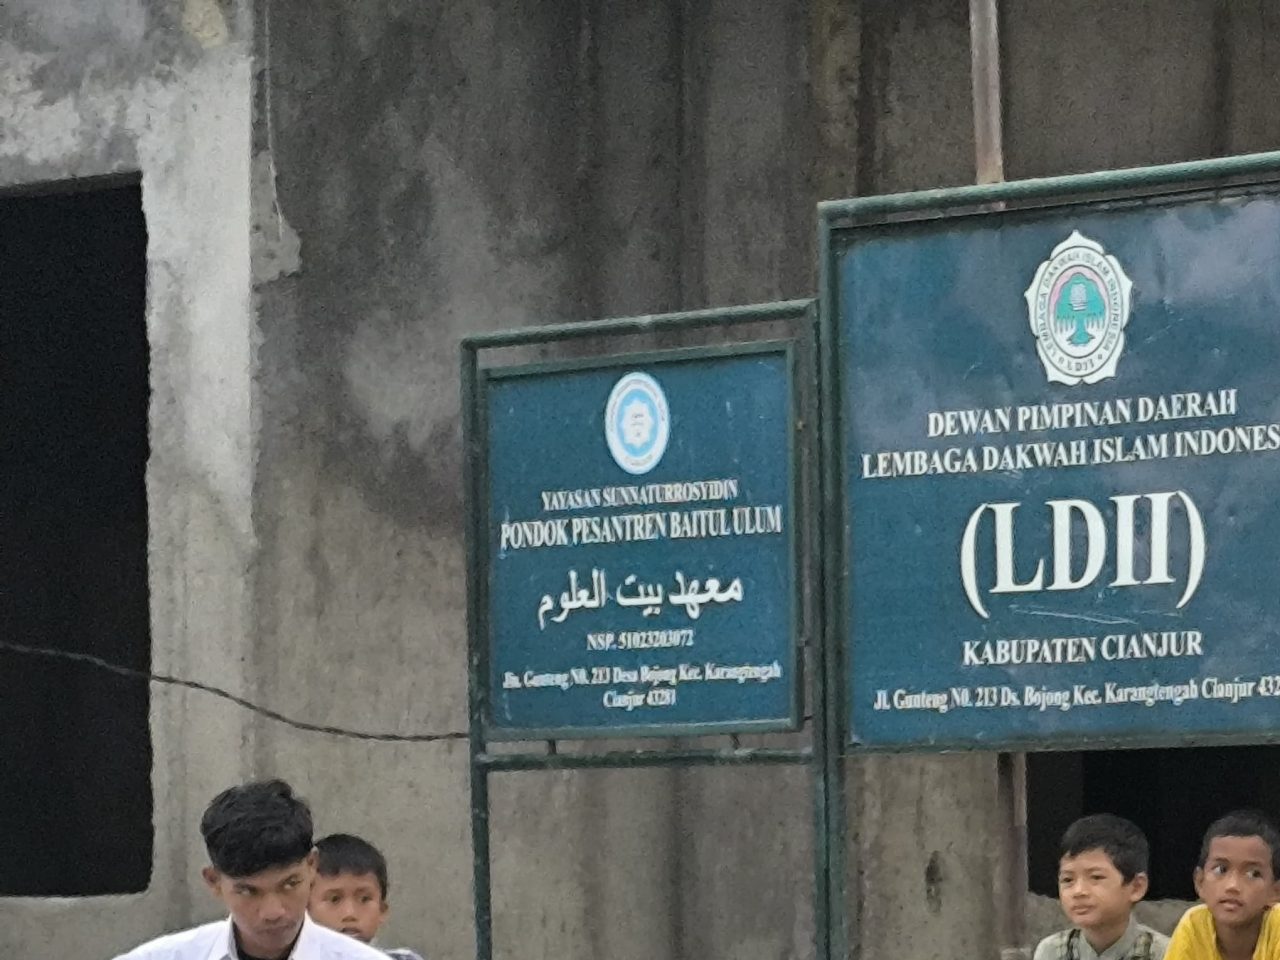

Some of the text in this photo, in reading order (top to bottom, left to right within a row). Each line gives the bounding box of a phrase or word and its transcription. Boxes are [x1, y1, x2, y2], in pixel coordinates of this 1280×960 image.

[928, 388, 1238, 438] DEWAN PIMPINAN DAERAH
[862, 447, 977, 479] LEMBAGA
[982, 438, 1086, 471] DAKWAH
[1093, 432, 1168, 465] ISLAM
[541, 489, 601, 511] YAYASAN
[501, 505, 783, 550] PONDOK PESANTREN BAITUL ULUM
[960, 489, 1206, 618] (LDII)
[537, 569, 744, 630] معهد بيت العلوم
[962, 630, 1203, 666] KABUPATEN CIANJUR
[1024, 684, 1070, 711] Bojong
[1105, 678, 1199, 706] Karangtengah
[1202, 676, 1257, 703] Cianjur
